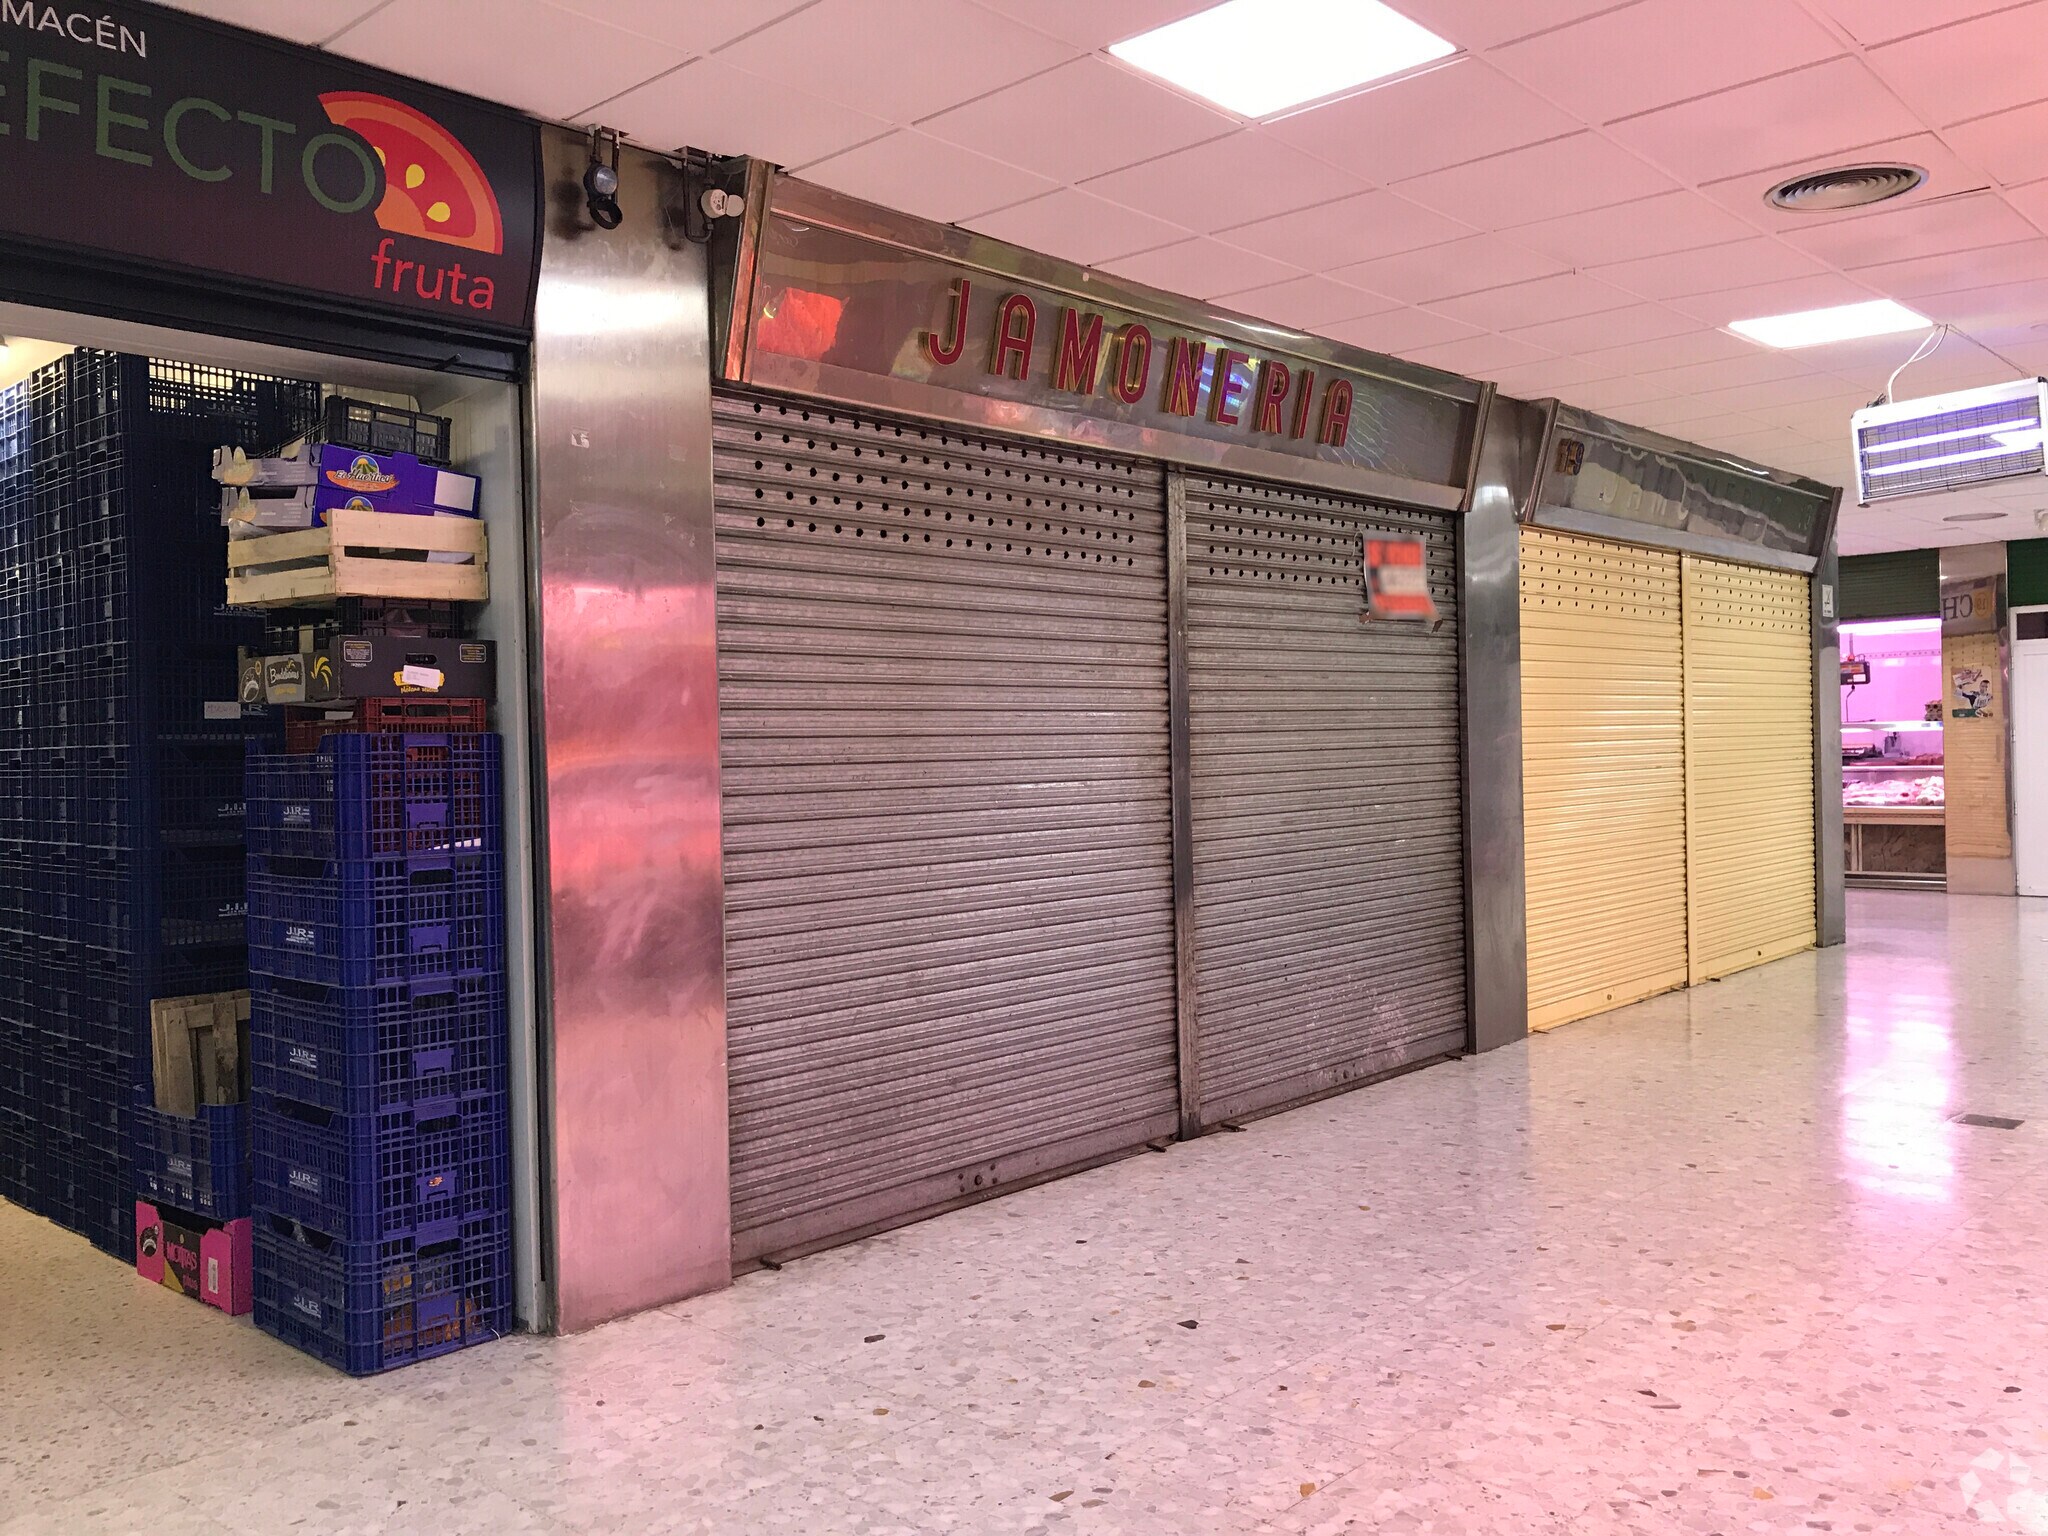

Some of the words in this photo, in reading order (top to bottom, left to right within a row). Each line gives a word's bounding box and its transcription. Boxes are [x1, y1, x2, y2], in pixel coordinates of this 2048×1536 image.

[2, 0, 147, 58] MACÉN
[0, 50, 376, 213] FECTO
[372, 238, 495, 310] fruta
[919, 278, 1355, 448] JAMONERIA
